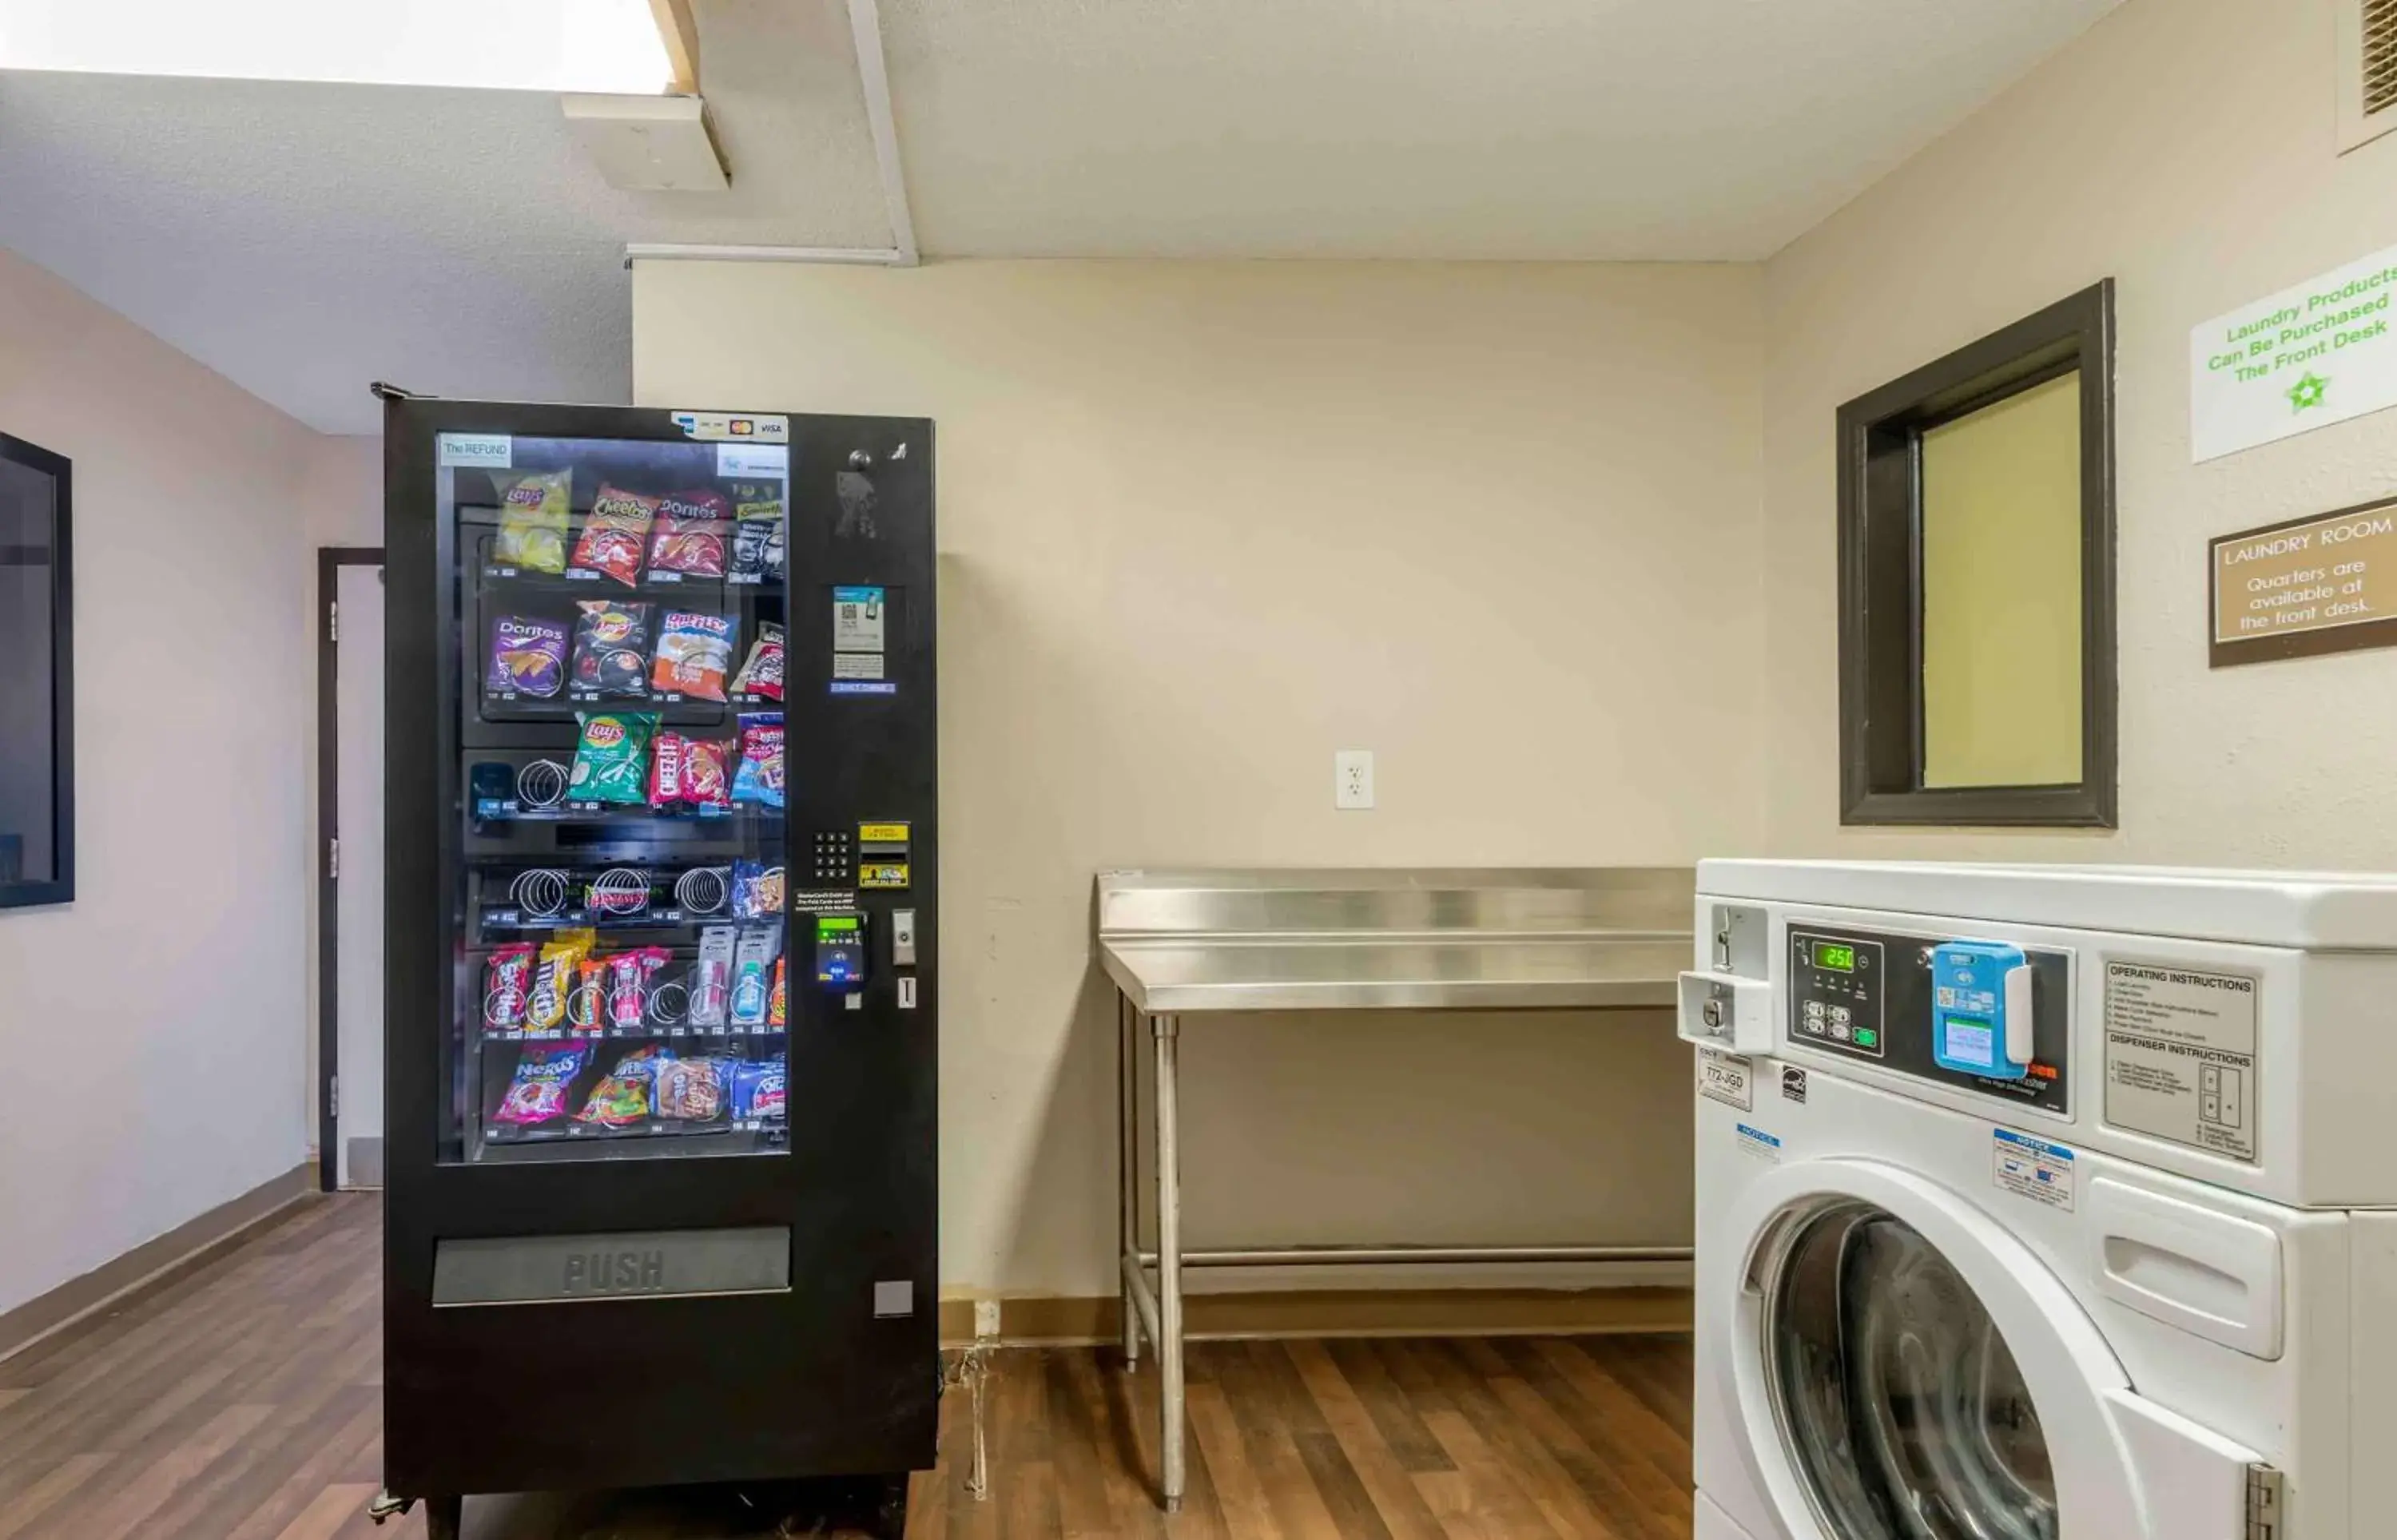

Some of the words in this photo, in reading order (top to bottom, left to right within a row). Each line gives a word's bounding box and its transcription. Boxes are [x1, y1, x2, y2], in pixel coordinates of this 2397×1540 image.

[2208, 350, 2243, 371] Can
[2249, 339, 2274, 357] Be
[2280, 292, 2390, 344] Purchased
[2225, 306, 2300, 343] Laundry
[2235, 363, 2269, 383] The
[2275, 340, 2327, 370] Front
[2333, 320, 2388, 350] Desk
[594, 498, 652, 520] Cheetos
[2224, 534, 2312, 566] LAUNDRY
[2320, 517, 2393, 546] ROOM
[2247, 567, 2326, 593] Quarters
[2333, 561, 2366, 577] are
[2249, 585, 2334, 610] available
[2342, 579, 2362, 594] at
[499, 622, 563, 640] Doritos
[2240, 615, 2269, 632] the
[2276, 606, 2316, 625] front
[2109, 965, 2168, 983] OPERATING
[2169, 973, 2252, 993] INSTRUCTIONS
[2109, 1034, 2166, 1053] DISPENSER
[2168, 1045, 2252, 1068] INSTRUCTIONS
[562, 1249, 665, 1292] PUSH
